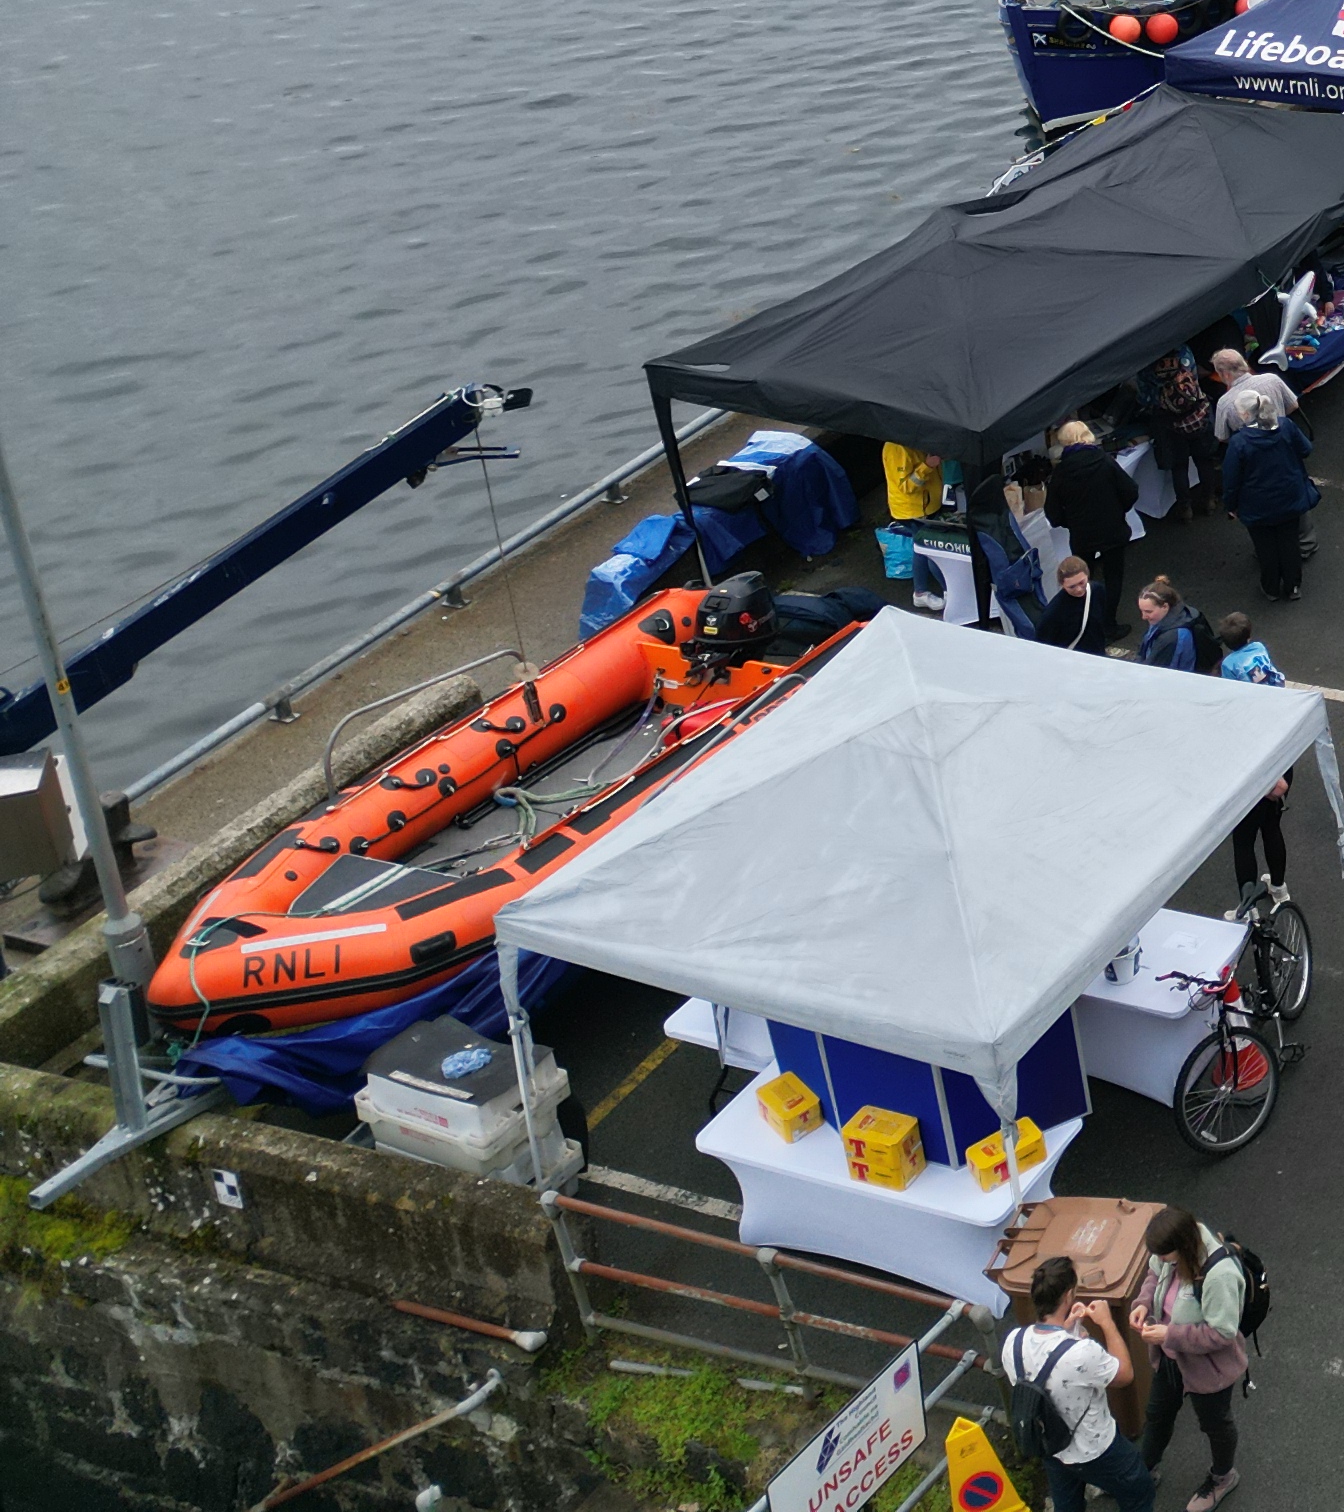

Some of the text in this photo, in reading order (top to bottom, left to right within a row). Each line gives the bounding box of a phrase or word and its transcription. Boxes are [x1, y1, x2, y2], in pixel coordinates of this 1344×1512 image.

[244, 944, 340, 988] RNLI
[850, 1138, 866, 1159] T
[852, 1161, 869, 1182] T
[809, 1418, 892, 1512] UNSAFE
[834, 1429, 914, 1512] ACCESS
